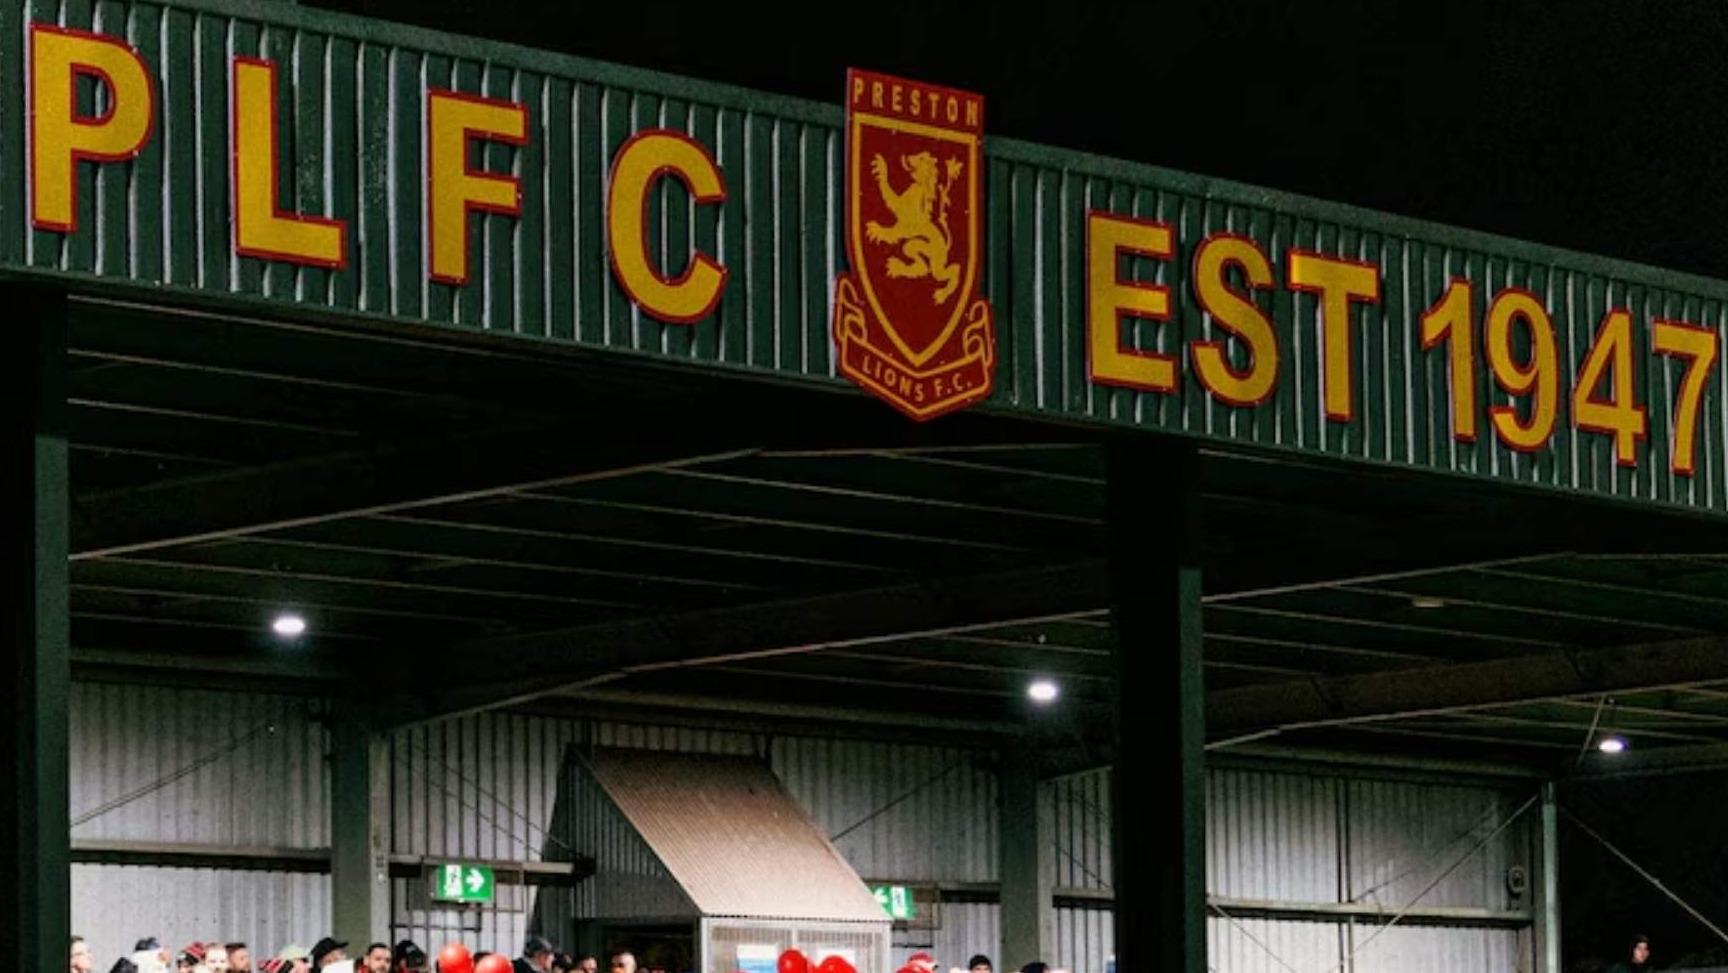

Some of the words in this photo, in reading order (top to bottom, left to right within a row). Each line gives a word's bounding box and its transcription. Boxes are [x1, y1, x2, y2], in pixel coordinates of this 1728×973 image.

[854, 78, 978, 126] PRESTON
[1087, 210, 1380, 421] EST
[1421, 279, 1719, 477] 1947
[862, 355, 925, 402] LIONS
[934, 374, 972, 397] F.C.
